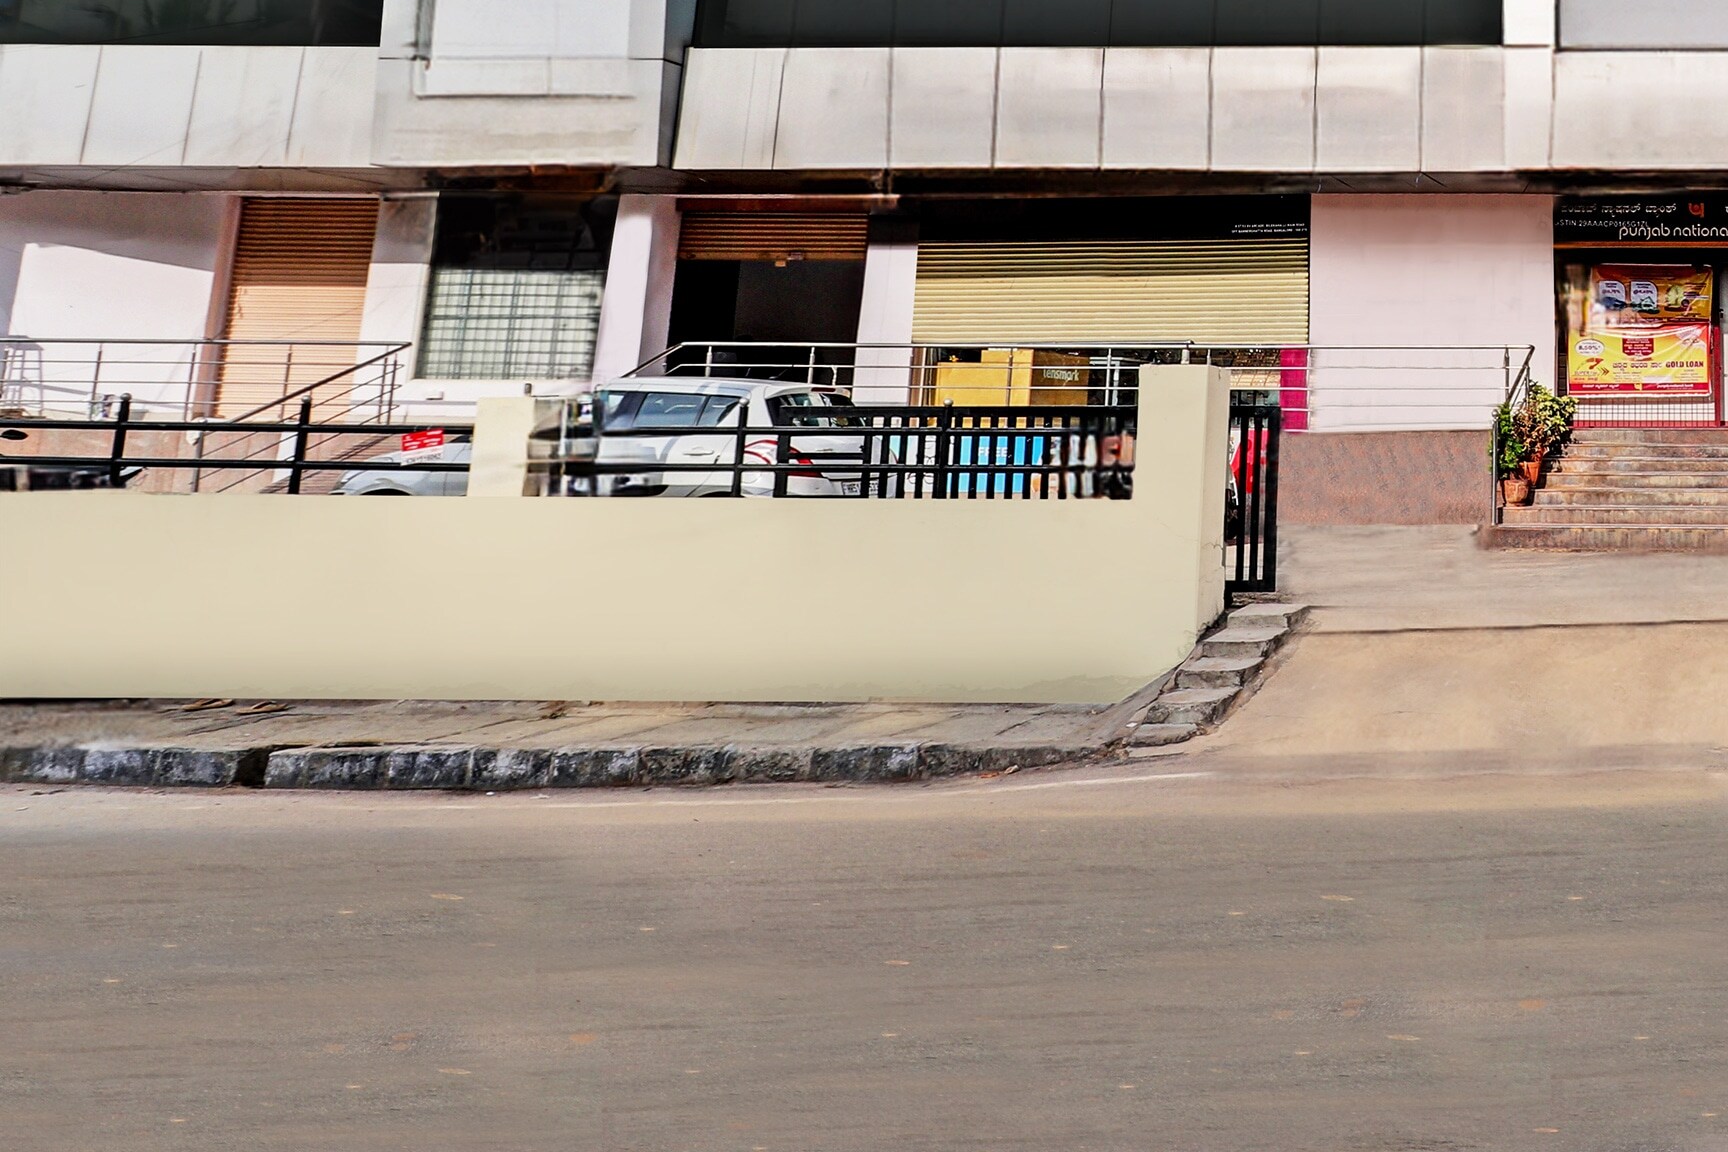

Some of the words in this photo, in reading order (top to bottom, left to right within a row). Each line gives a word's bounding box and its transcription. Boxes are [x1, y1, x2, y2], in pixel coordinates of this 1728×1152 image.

[1619, 223, 1671, 240] punjab
[1665, 360, 1684, 369] GOLD
[1685, 360, 1704, 369] LOAN
